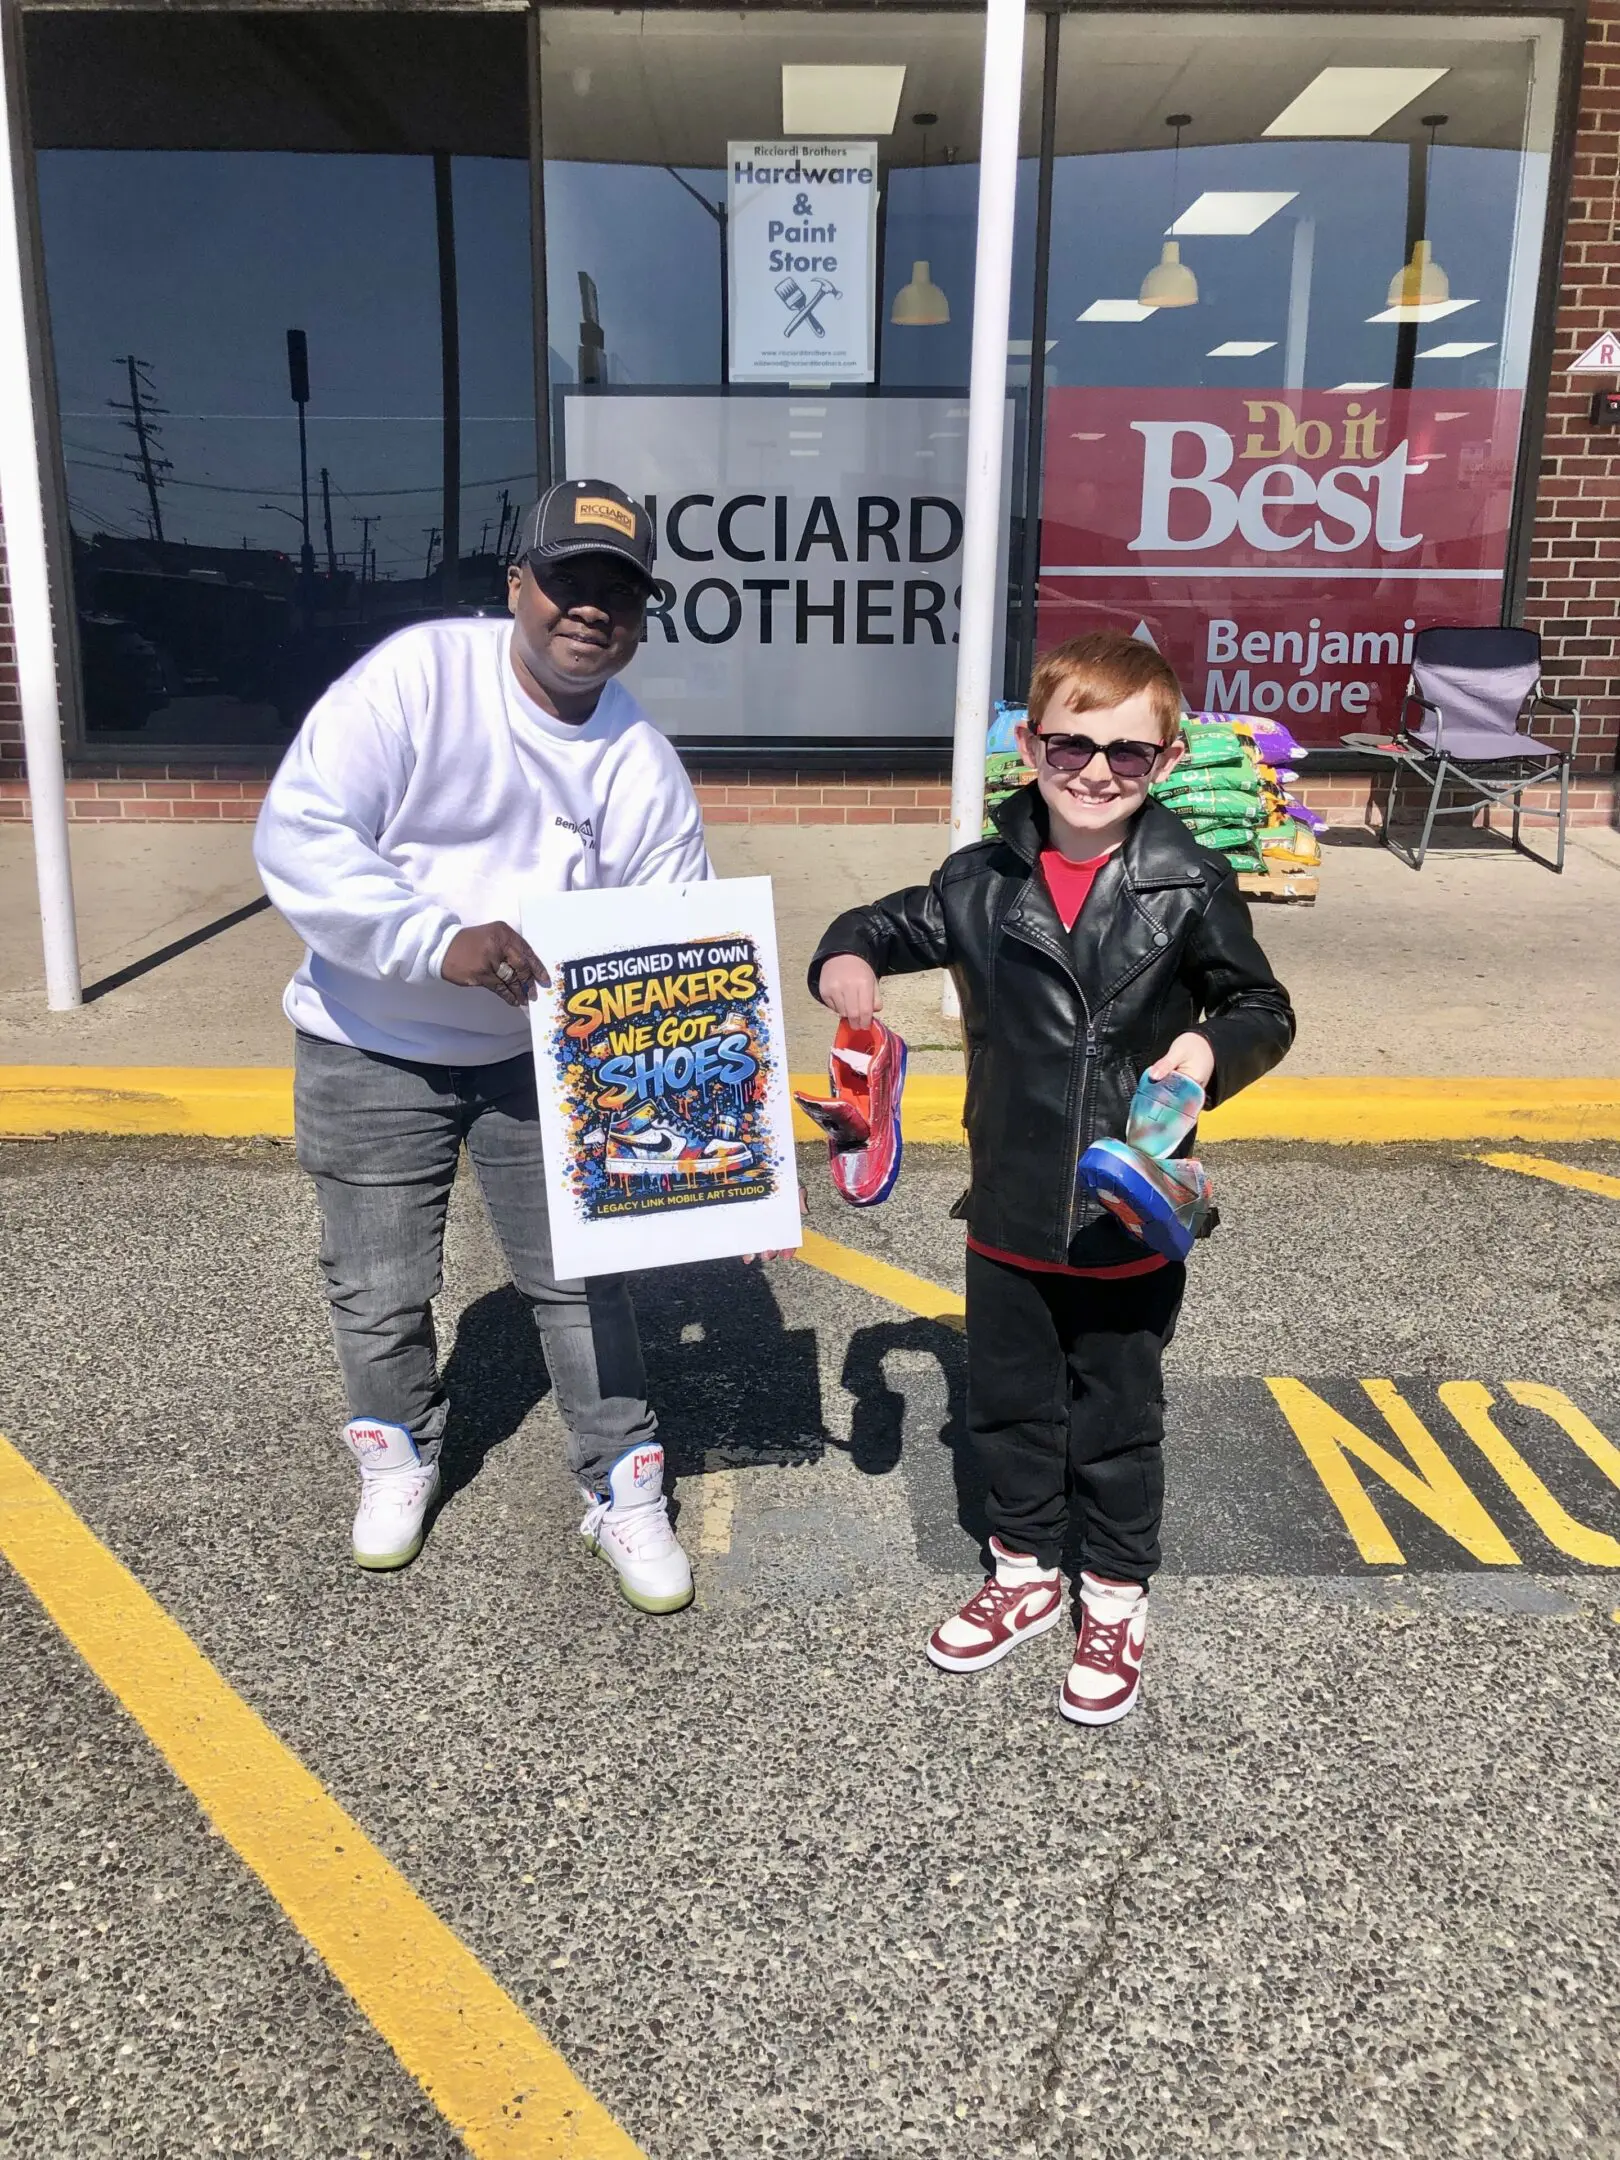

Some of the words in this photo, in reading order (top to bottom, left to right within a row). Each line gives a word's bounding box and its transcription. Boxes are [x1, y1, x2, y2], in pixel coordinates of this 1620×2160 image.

[734, 160, 873, 185] Hardware
[754, 146, 798, 157] Ricciardi
[803, 146, 847, 157] Brothers
[792, 193, 813, 216] &
[768, 220, 837, 243] Paint
[768, 250, 838, 272] Store
[1600, 344, 1614, 364] R
[1240, 400, 1332, 460] Do
[1340, 403, 1387, 460] it
[1127, 420, 1429, 552] Best
[580, 504, 632, 527] RICCIARDI
[645, 494, 965, 562] ICCIARD
[641, 578, 965, 645] ROTHER
[1206, 619, 1415, 676] Benjami
[1205, 670, 1370, 714] Moore
[570, 968, 578, 990] I
[583, 953, 673, 987] DESIGNED
[678, 948, 705, 970] MY
[708, 945, 749, 965] OWN
[566, 964, 757, 1038] SNEAKERS
[609, 1025, 654, 1056] WE
[657, 1015, 716, 1048] GOT
[597, 1034, 756, 1107] SHOES
[597, 1200, 639, 1214] LEGACY
[641, 1199, 666, 1209] LINK
[667, 1194, 705, 1205] MOBILE
[706, 1190, 725, 1200] ART
[728, 1185, 765, 1197] STUDIO
[349, 1429, 389, 1449] EWING
[1263, 1376, 1620, 1567] NO
